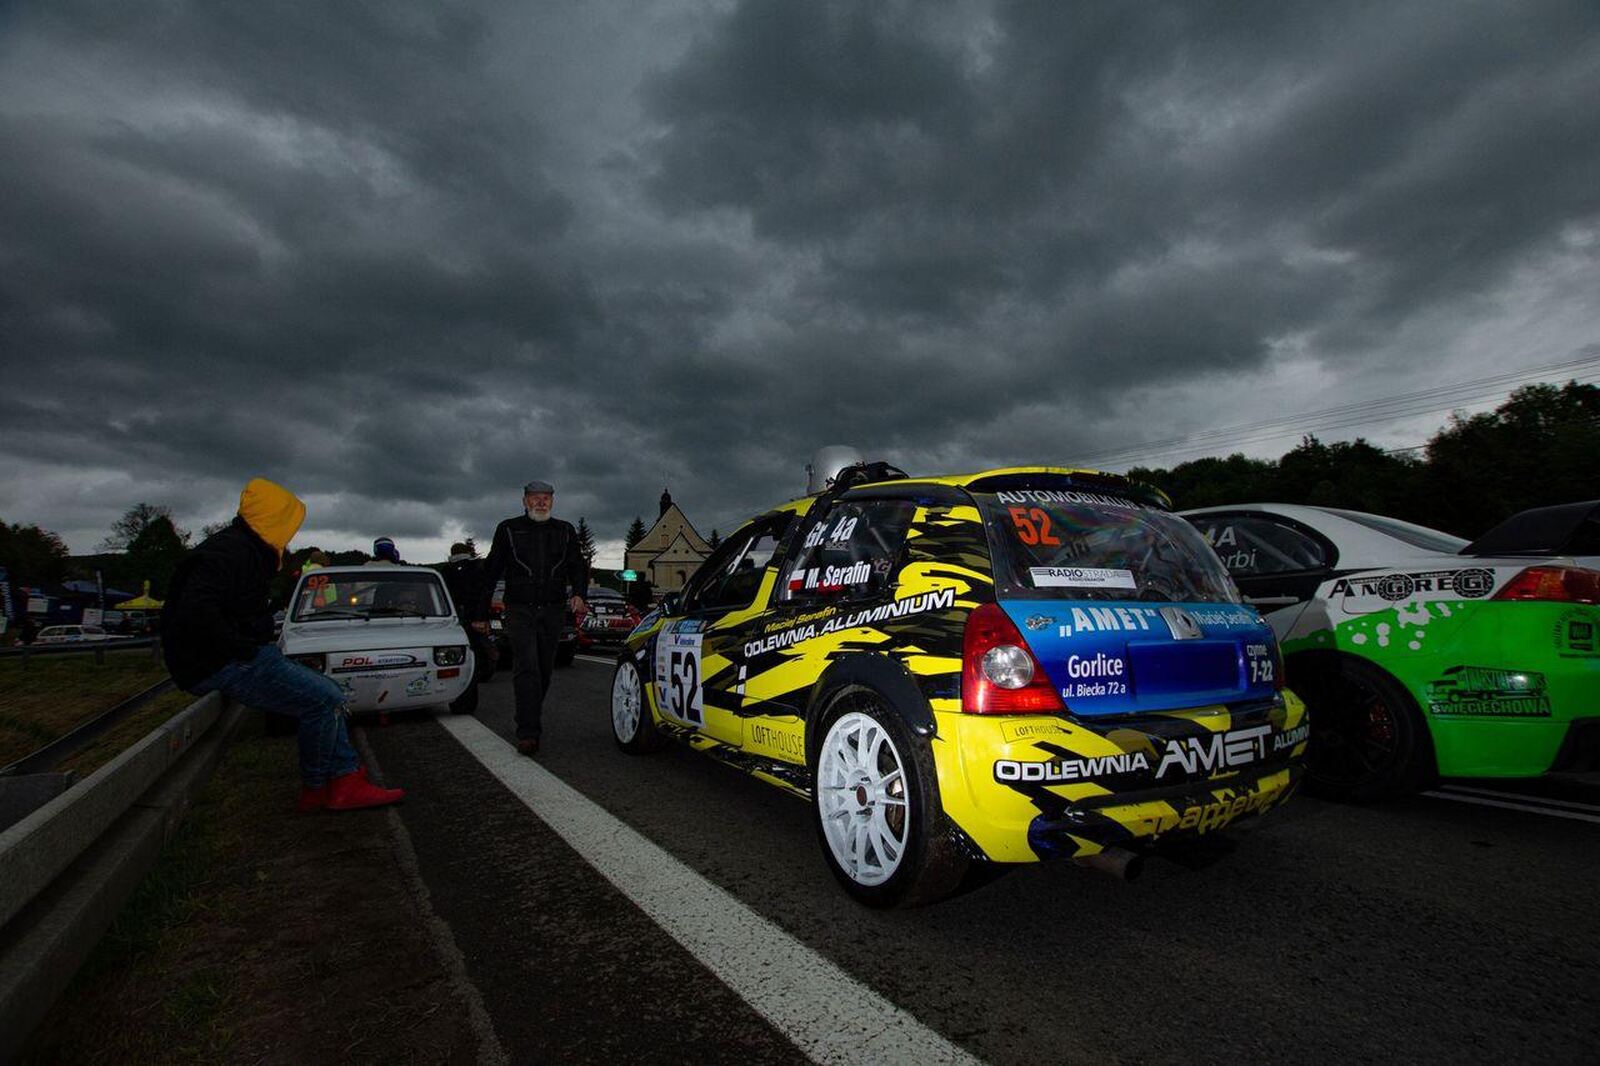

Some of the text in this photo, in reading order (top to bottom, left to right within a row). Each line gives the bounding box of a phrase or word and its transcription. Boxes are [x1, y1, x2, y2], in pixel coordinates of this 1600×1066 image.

[805, 520, 828, 549] Gr.
[829, 515, 858, 542] 4a
[1008, 505, 1061, 547] 52
[1221, 548, 1257, 569] rbi
[804, 566, 821, 590] M.
[823, 560, 871, 587] Serafin
[744, 588, 955, 658] ODLEWNIA ALUMINIUM
[342, 657, 373, 667] POL
[1067, 653, 1124, 680] Gorlice
[1250, 659, 1274, 684] 7-22
[671, 651, 702, 724] 52
[1062, 681, 1126, 698] ul. Biecka 72 a
[752, 723, 805, 758] LOFTHOUSE
[995, 751, 1150, 782] ODLEWNIA
[1154, 724, 1273, 780] AMET
